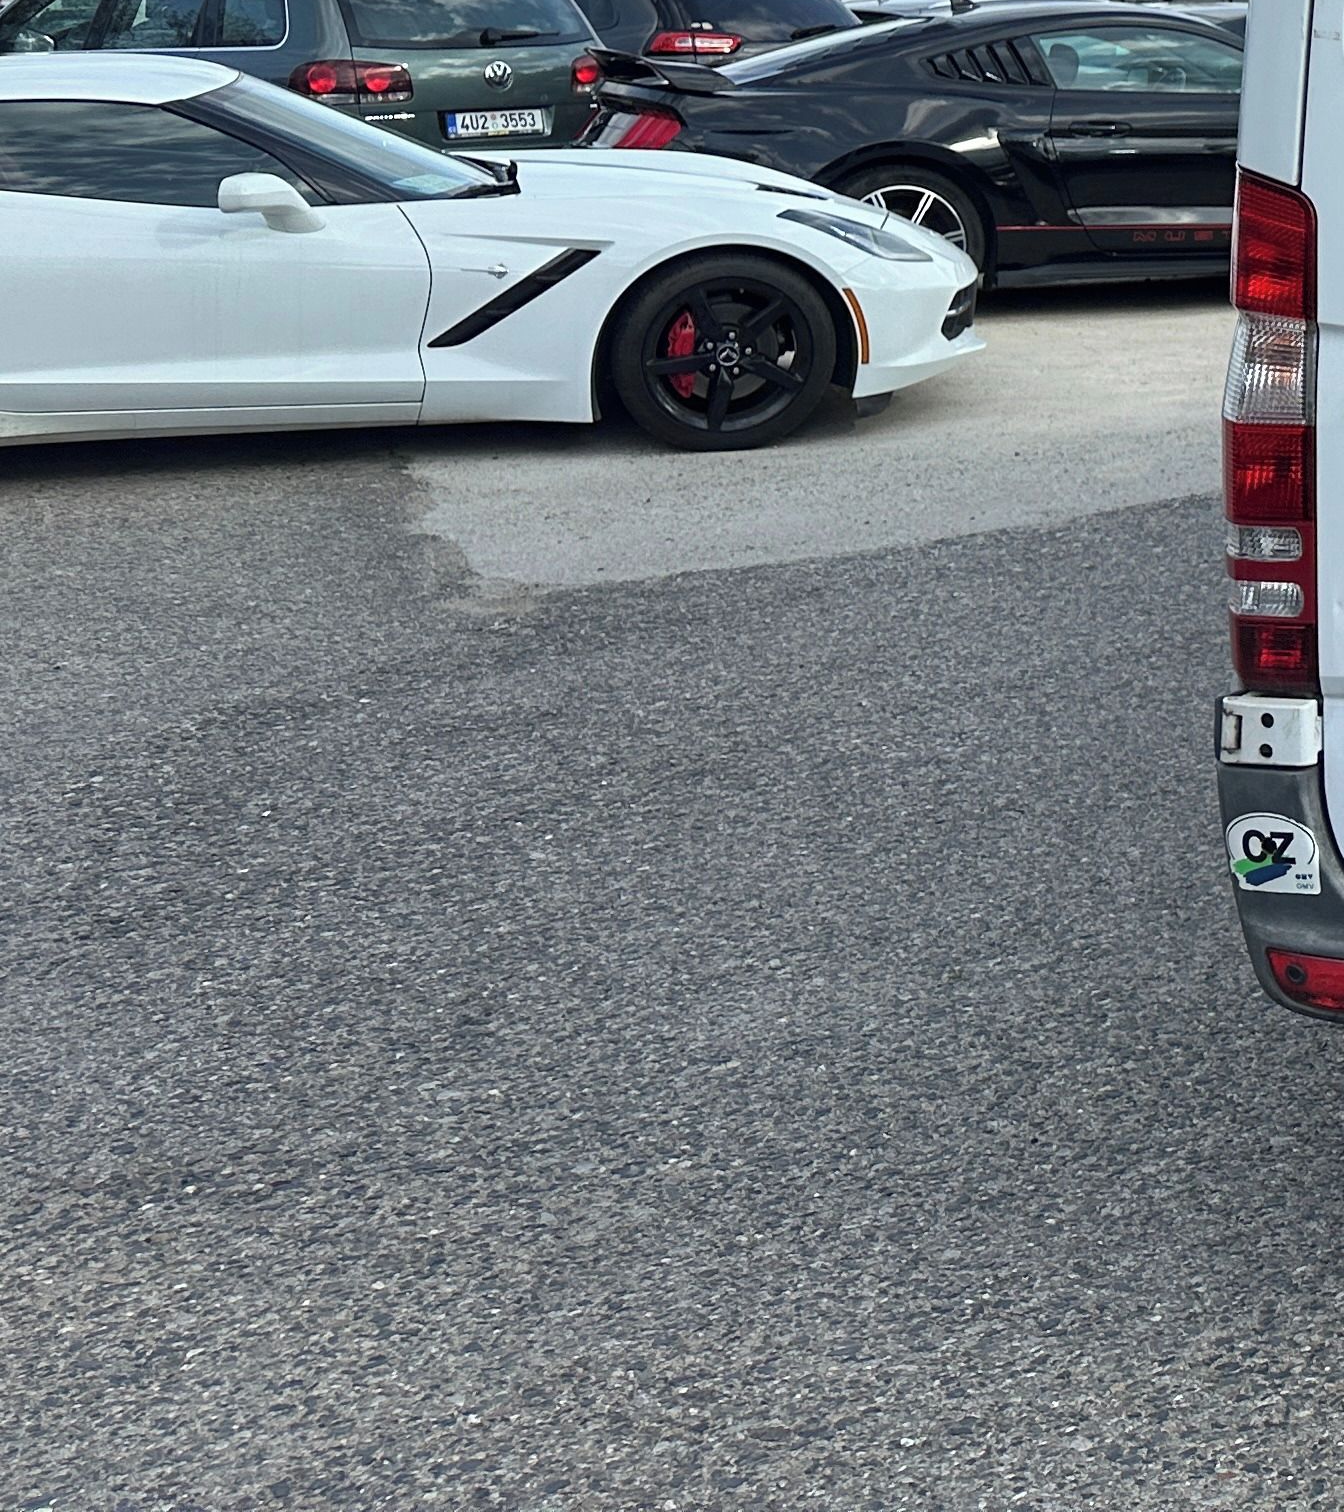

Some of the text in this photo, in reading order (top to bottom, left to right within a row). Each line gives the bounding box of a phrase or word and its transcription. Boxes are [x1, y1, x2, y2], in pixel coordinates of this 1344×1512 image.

[460, 115, 490, 132] 4U2
[501, 111, 537, 129] 3553
[1242, 829, 1297, 865] CZ
